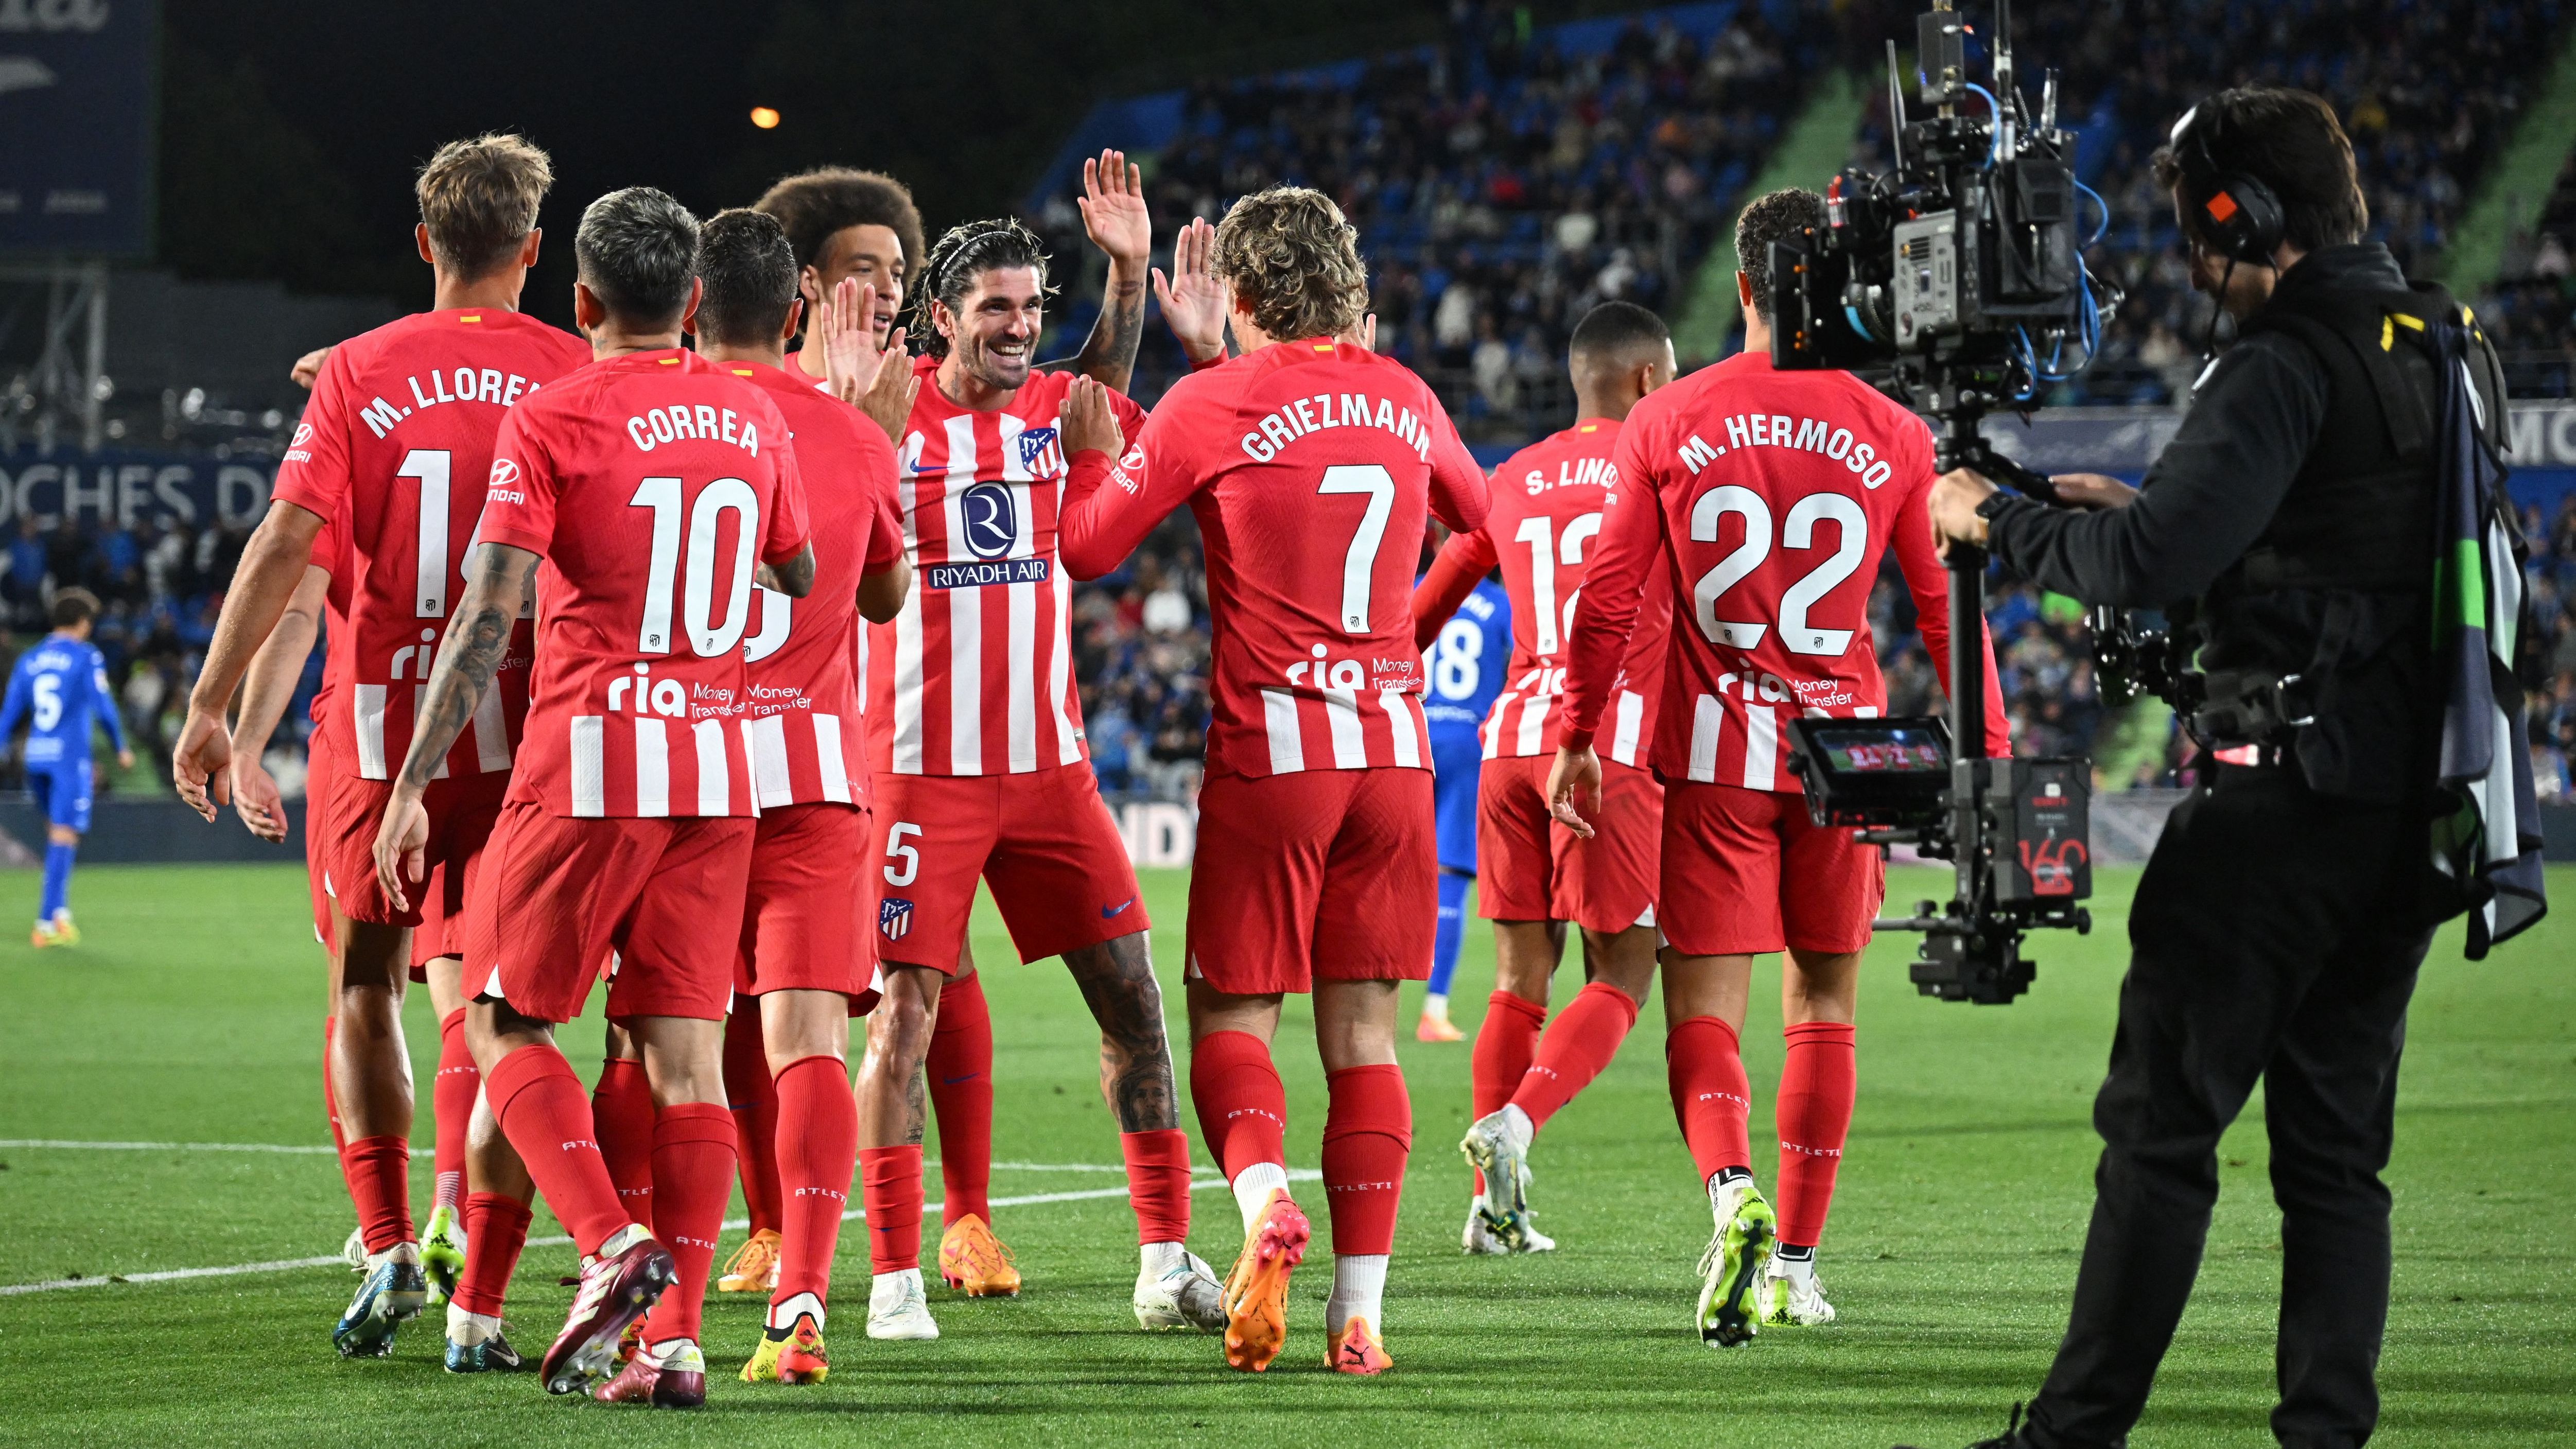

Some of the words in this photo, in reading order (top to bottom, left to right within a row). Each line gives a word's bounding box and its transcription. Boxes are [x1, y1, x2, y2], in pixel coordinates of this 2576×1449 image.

[360, 395, 412, 440] M.
[627, 405, 759, 458] CORREA
[1241, 393, 1430, 463] GRIEZMANN
[1678, 434, 1726, 475] M.
[1725, 414, 1891, 490] HERMOSO
[1111, 465, 1138, 495] NDAI
[1525, 469, 1553, 496] S.
[628, 477, 760, 658] 10
[1317, 464, 1395, 634] 7
[1690, 484, 1868, 656] 22
[933, 565, 1010, 586] RIYADH
[1017, 562, 1046, 580] AIR
[391, 627, 434, 680] ri
[1285, 643, 1365, 690] ria
[1372, 658, 1414, 675] Money
[32, 673, 63, 732] 5
[608, 660, 686, 718] ria
[693, 682, 735, 705] Money
[1372, 676, 1423, 690] Transfer
[1718, 657, 1791, 703] ria
[690, 701, 745, 719] Transfer
[883, 821, 923, 887] 5
[1782, 1141, 1840, 1157] ATLETI
[619, 1186, 653, 1196] TLE
[675, 1236, 716, 1251] ATLE
